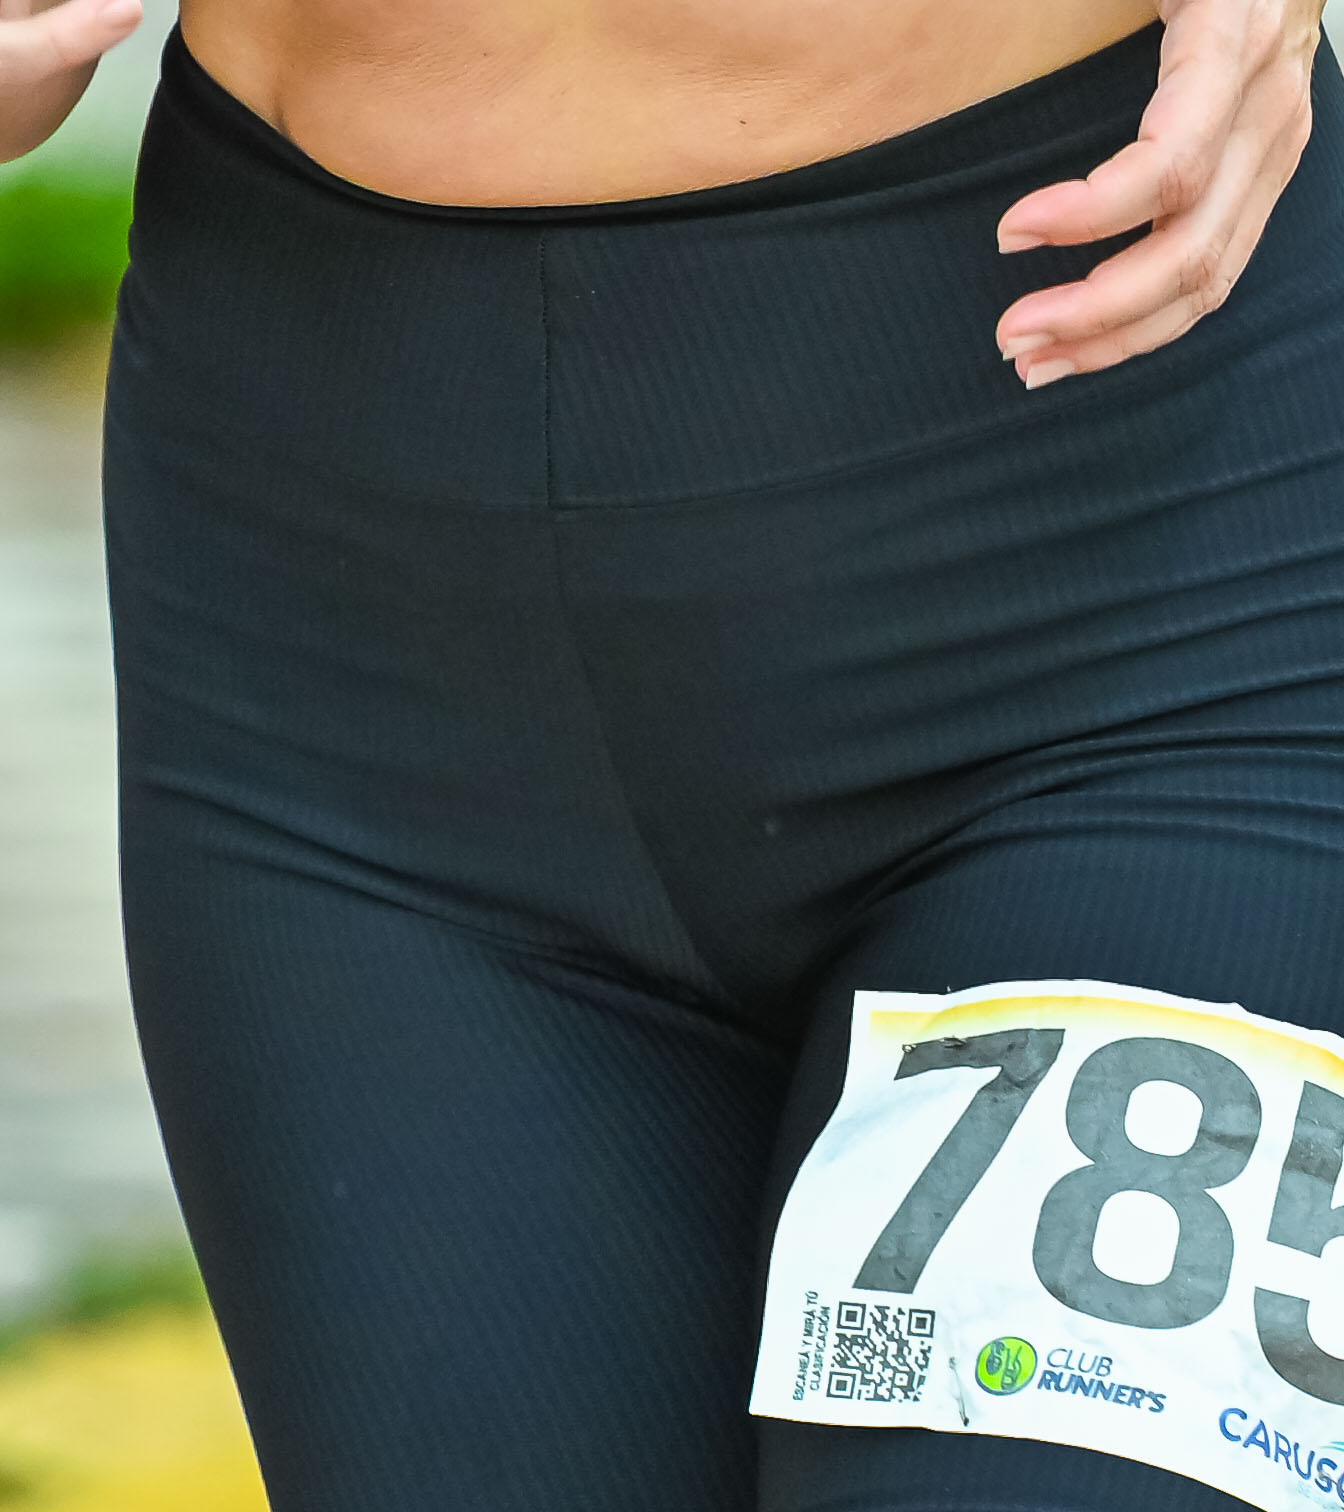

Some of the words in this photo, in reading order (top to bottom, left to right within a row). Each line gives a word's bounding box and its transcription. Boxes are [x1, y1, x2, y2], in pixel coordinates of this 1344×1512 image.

[805, 1290, 819, 1306] TÚ
[803, 1309, 816, 1337] MIRÁ
[810, 1306, 830, 1391] CLASIFICACIÓN
[1046, 1347, 1113, 1377] CLUB
[1036, 1369, 1168, 1413] RUNNER'S
